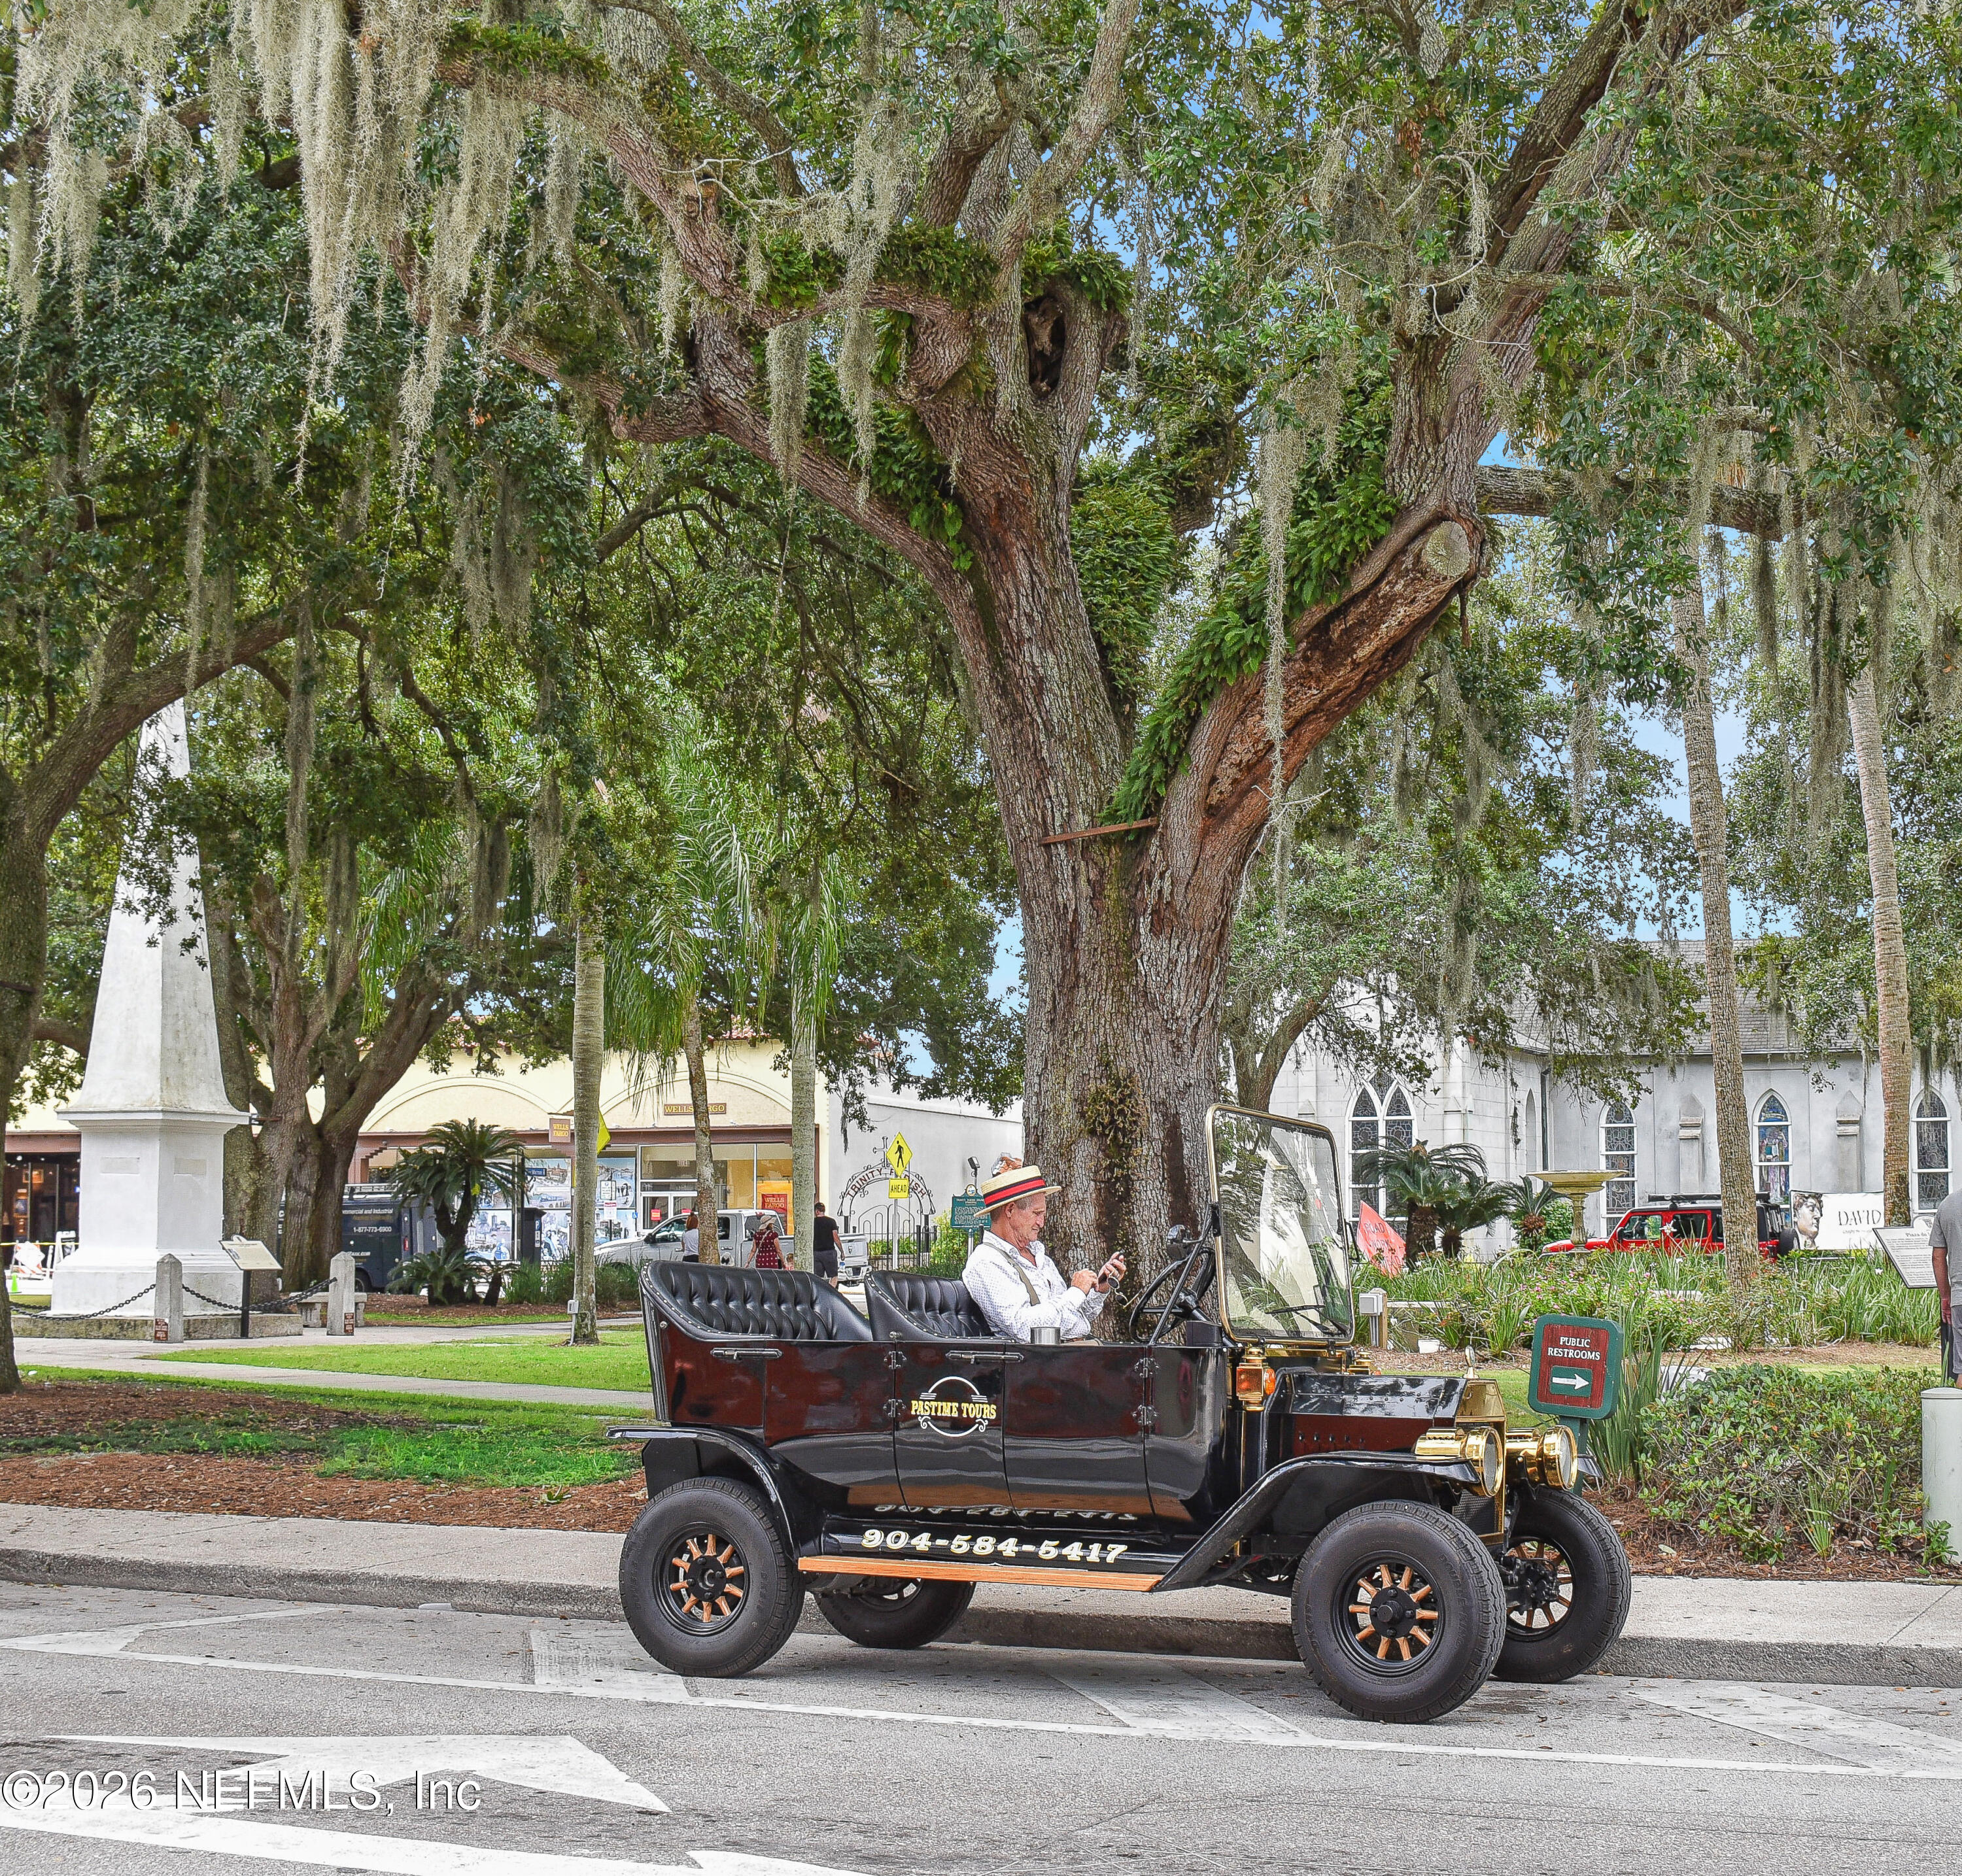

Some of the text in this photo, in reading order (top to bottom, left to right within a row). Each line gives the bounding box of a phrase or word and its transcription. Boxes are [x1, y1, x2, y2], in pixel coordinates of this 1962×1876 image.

[664, 1104, 693, 1113] WELLS
[847, 1167, 927, 1199] TRINITY PRISH
[890, 1184, 907, 1193] AHEAD
[1838, 1209, 1882, 1226] DAVID
[1364, 1222, 1385, 1234] ROAD
[1559, 1337, 1591, 1348] PUBLIC
[1547, 1347, 1601, 1361] RESTROOMS
[910, 1400, 997, 1419] PASTIME TOURS
[861, 1529, 1127, 1563] 904-584-5417
